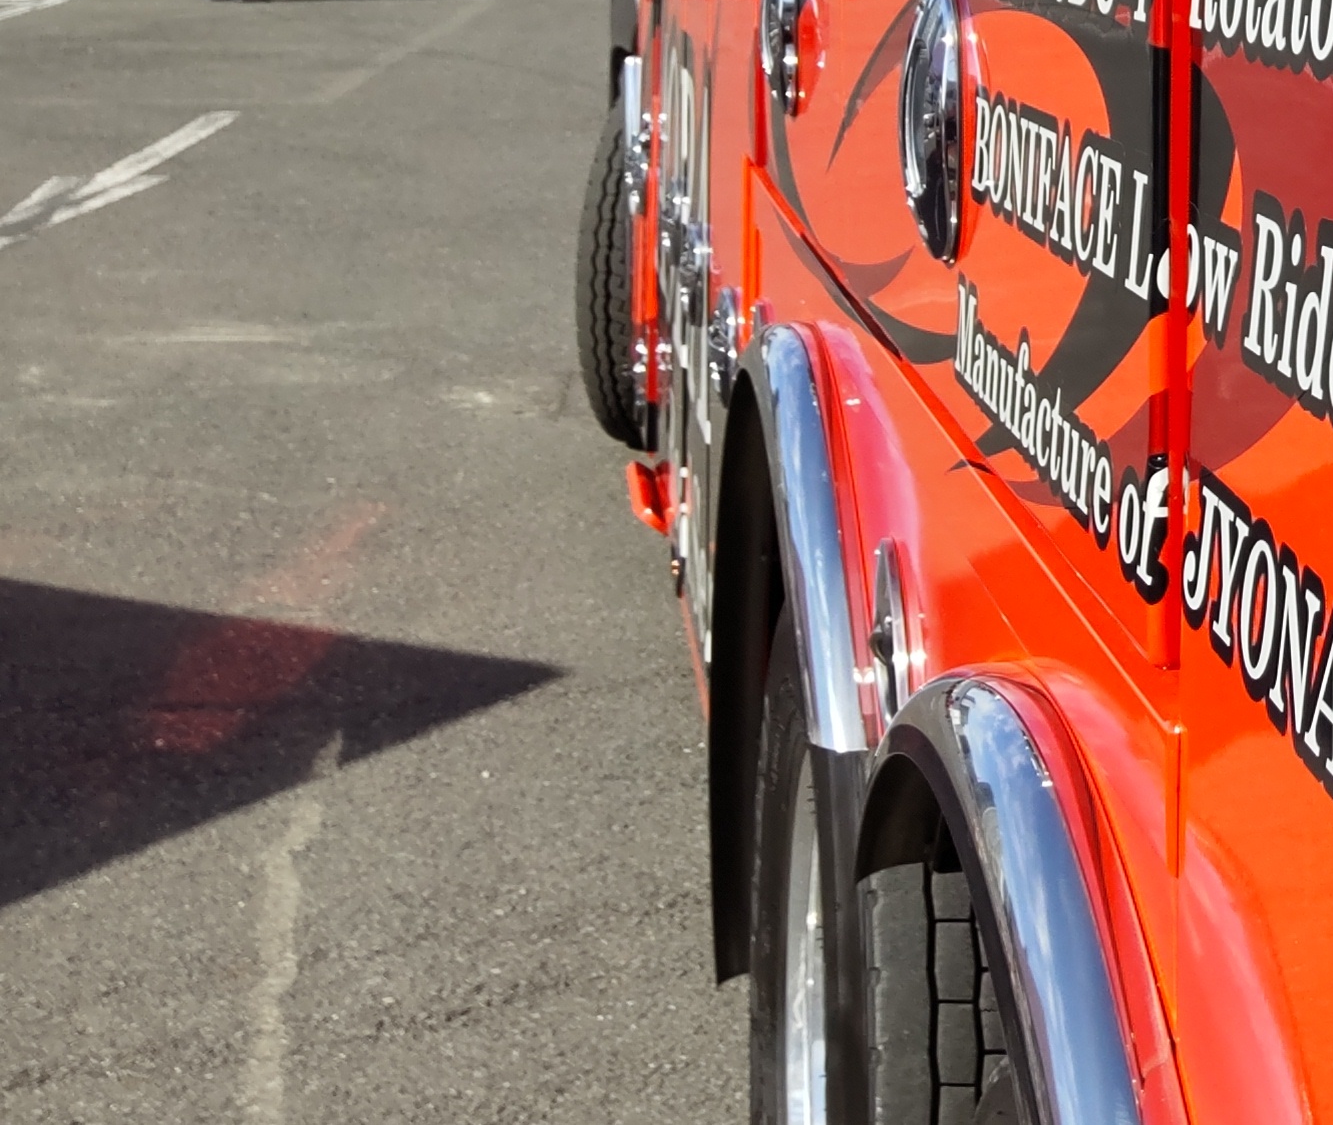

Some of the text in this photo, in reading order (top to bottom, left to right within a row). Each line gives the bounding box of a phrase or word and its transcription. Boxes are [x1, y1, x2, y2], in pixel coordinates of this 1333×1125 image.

[972, 96, 1122, 278] BONIFACE
[1124, 169, 1238, 332] Low
[954, 285, 1112, 534] Manufacture
[1119, 464, 1190, 586] of
